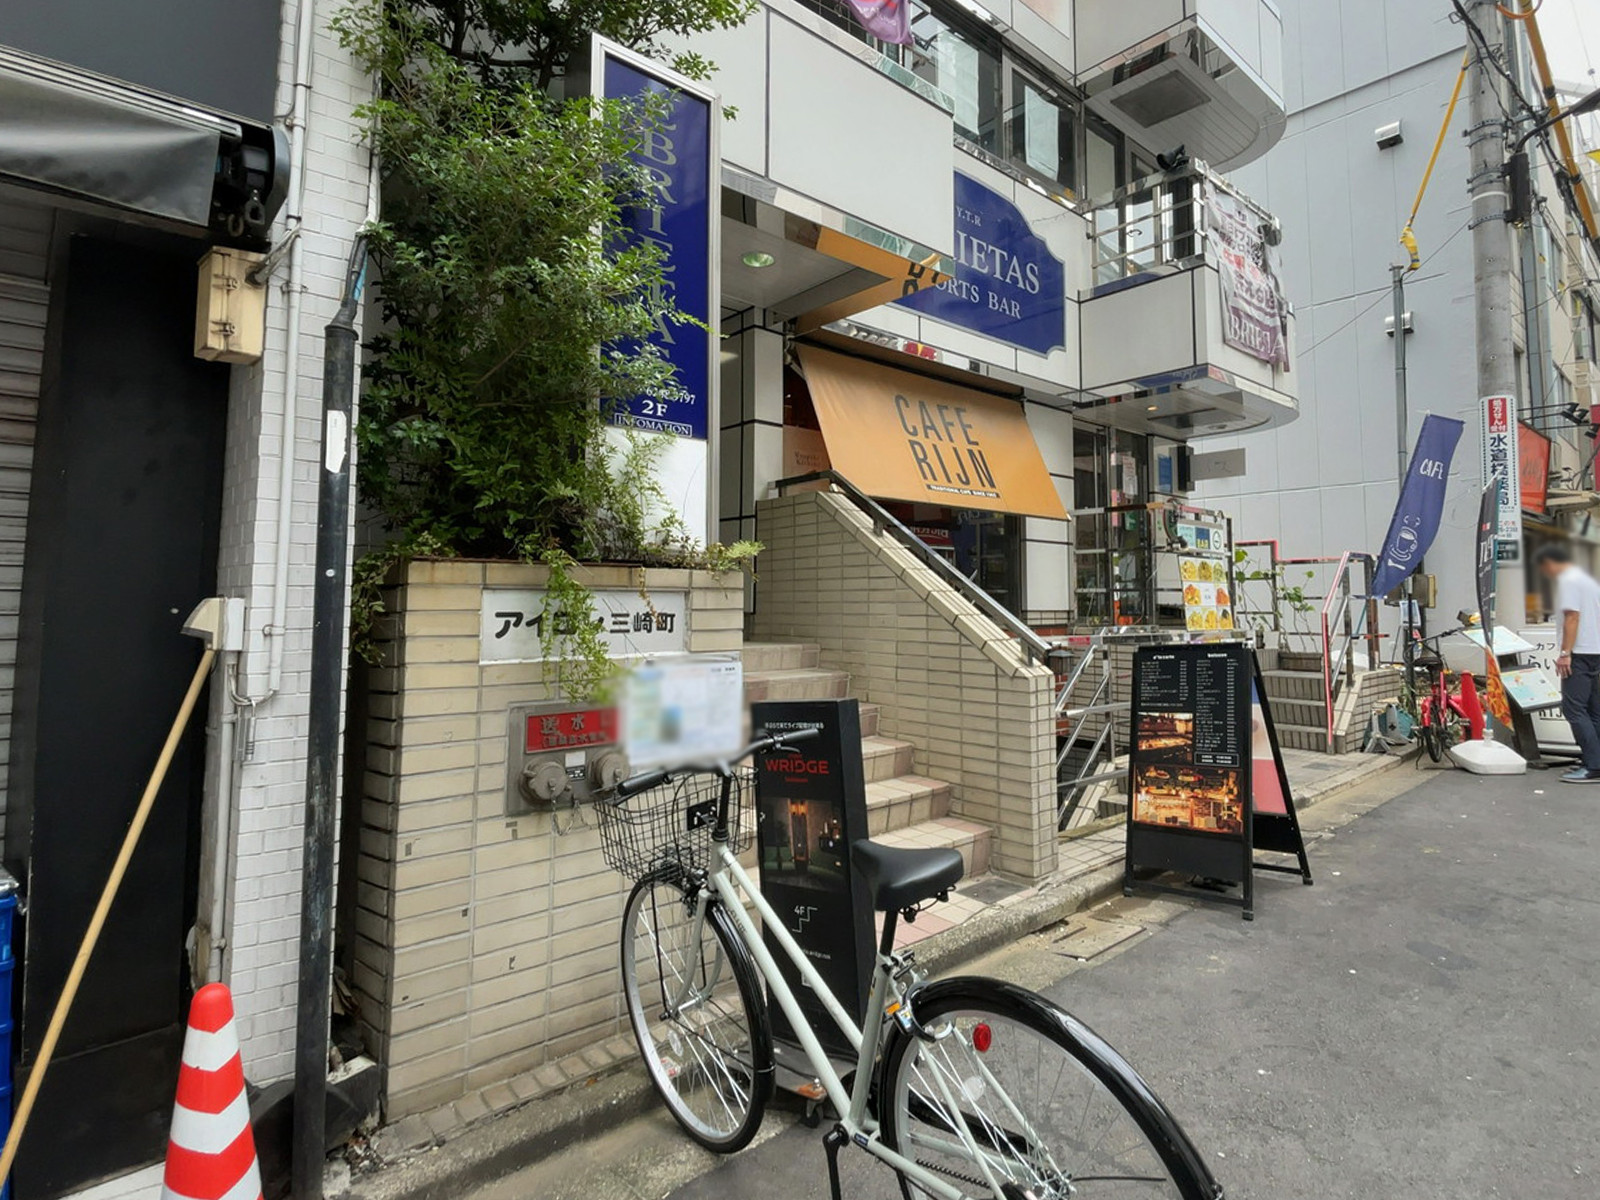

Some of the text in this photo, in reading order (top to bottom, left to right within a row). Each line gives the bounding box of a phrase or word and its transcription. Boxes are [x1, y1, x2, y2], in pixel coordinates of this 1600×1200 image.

[987, 290, 1021, 319] BAR
[641, 400, 668, 417] 2F
[894, 394, 979, 446] CAFE
[908, 438, 997, 489] RIJN
[765, 758, 829, 775] WRIDGE
[794, 904, 805, 916] 4F
